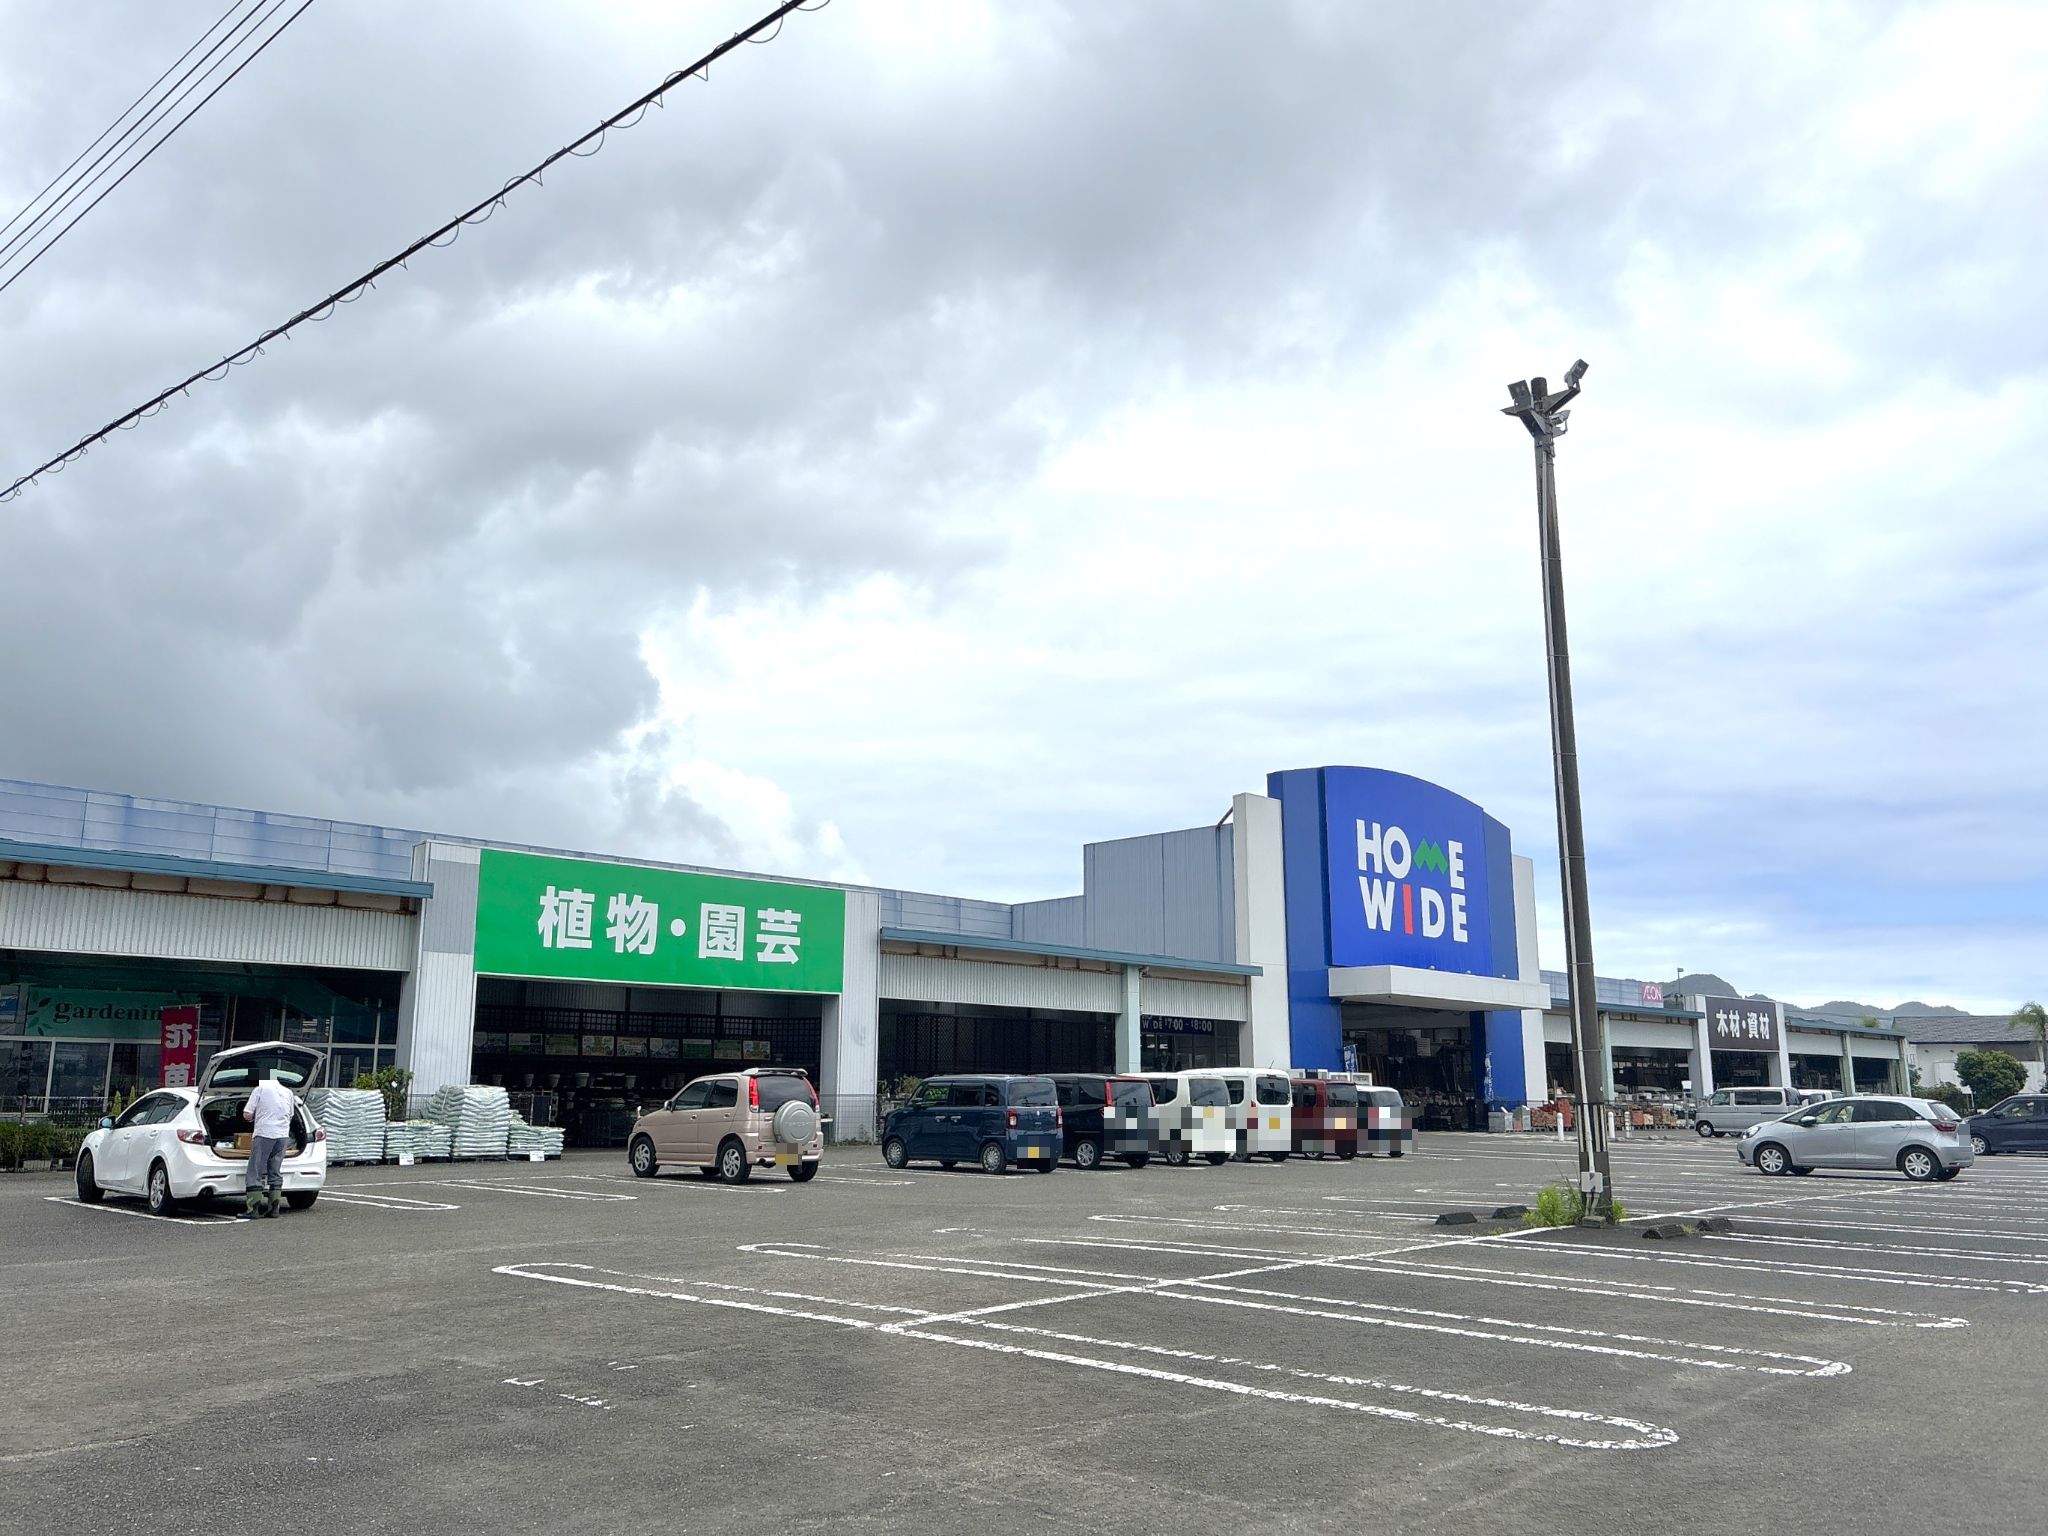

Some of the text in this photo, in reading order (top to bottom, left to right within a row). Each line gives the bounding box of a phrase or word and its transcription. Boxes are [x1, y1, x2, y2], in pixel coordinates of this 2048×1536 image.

[1356, 818, 1465, 890] HOME
[537, 885, 801, 965] 植物・園芸
[1358, 875, 1468, 943] WIDE
[52, 1002, 162, 1024] gardenin
[1142, 1019, 1163, 1030] WDE
[1716, 1009, 1770, 1040] 木材・資材
